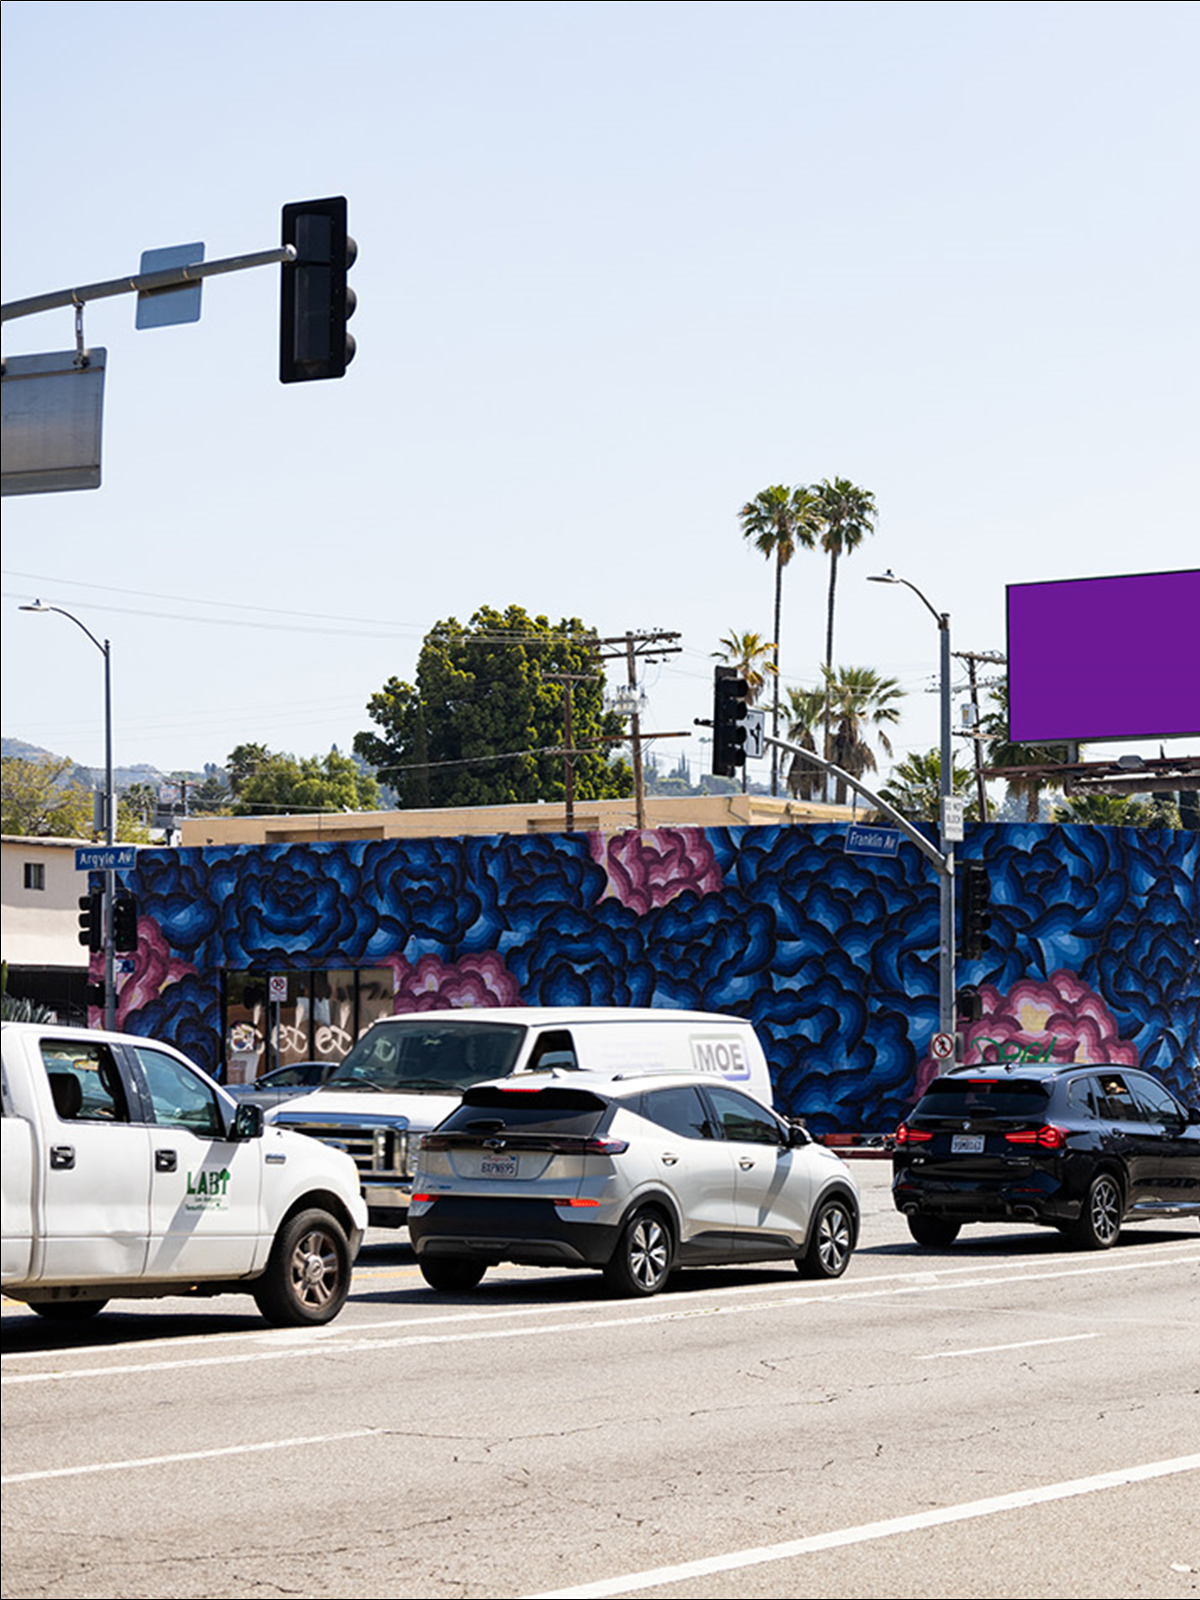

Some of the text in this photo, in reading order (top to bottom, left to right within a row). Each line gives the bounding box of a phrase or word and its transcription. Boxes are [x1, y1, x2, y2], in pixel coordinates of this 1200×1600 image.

[849, 831, 896, 849] Franklin Av
[80, 851, 132, 867] Argyle Av
[696, 1043, 745, 1072] MOE
